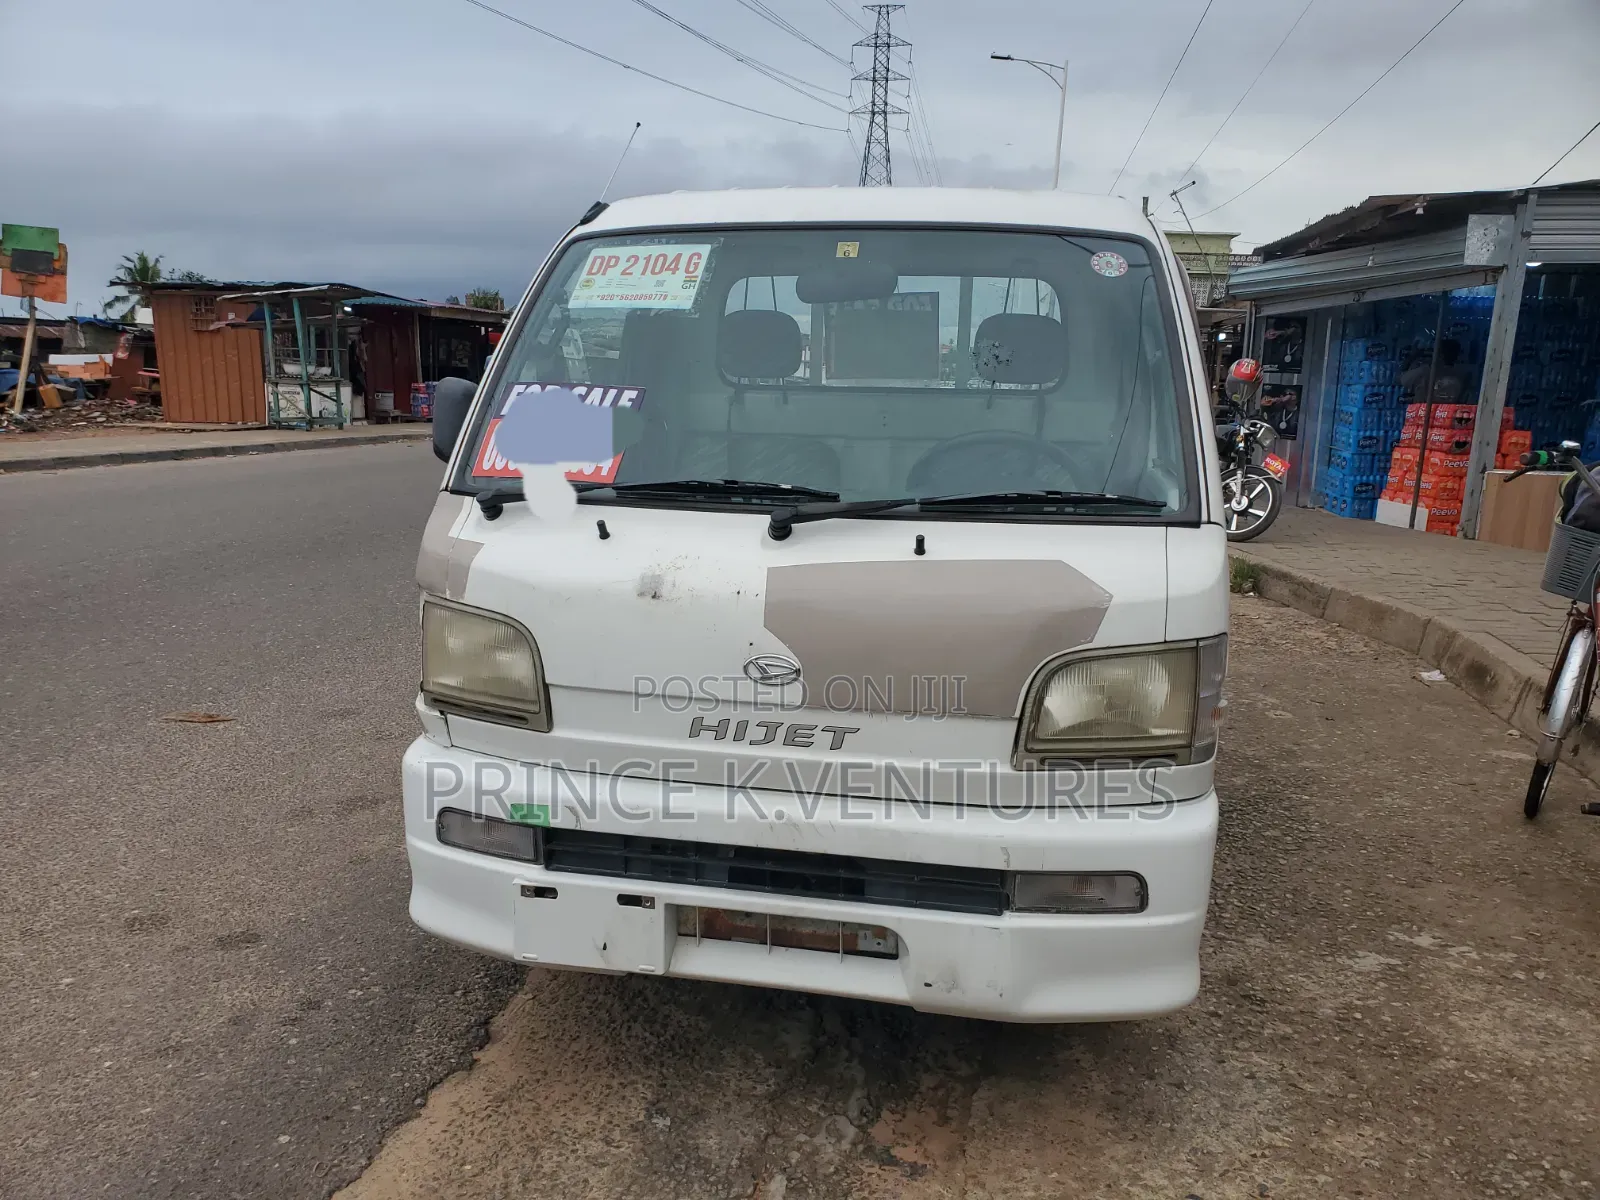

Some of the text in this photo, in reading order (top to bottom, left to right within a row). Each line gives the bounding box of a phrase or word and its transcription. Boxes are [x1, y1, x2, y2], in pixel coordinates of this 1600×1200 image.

[586, 251, 702, 276] DP 2104 G
[681, 282, 697, 290] GH
[1264, 456, 1286, 473] ROYAL
[1431, 508, 1457, 516] Peeva
[688, 716, 860, 750] HIJET
